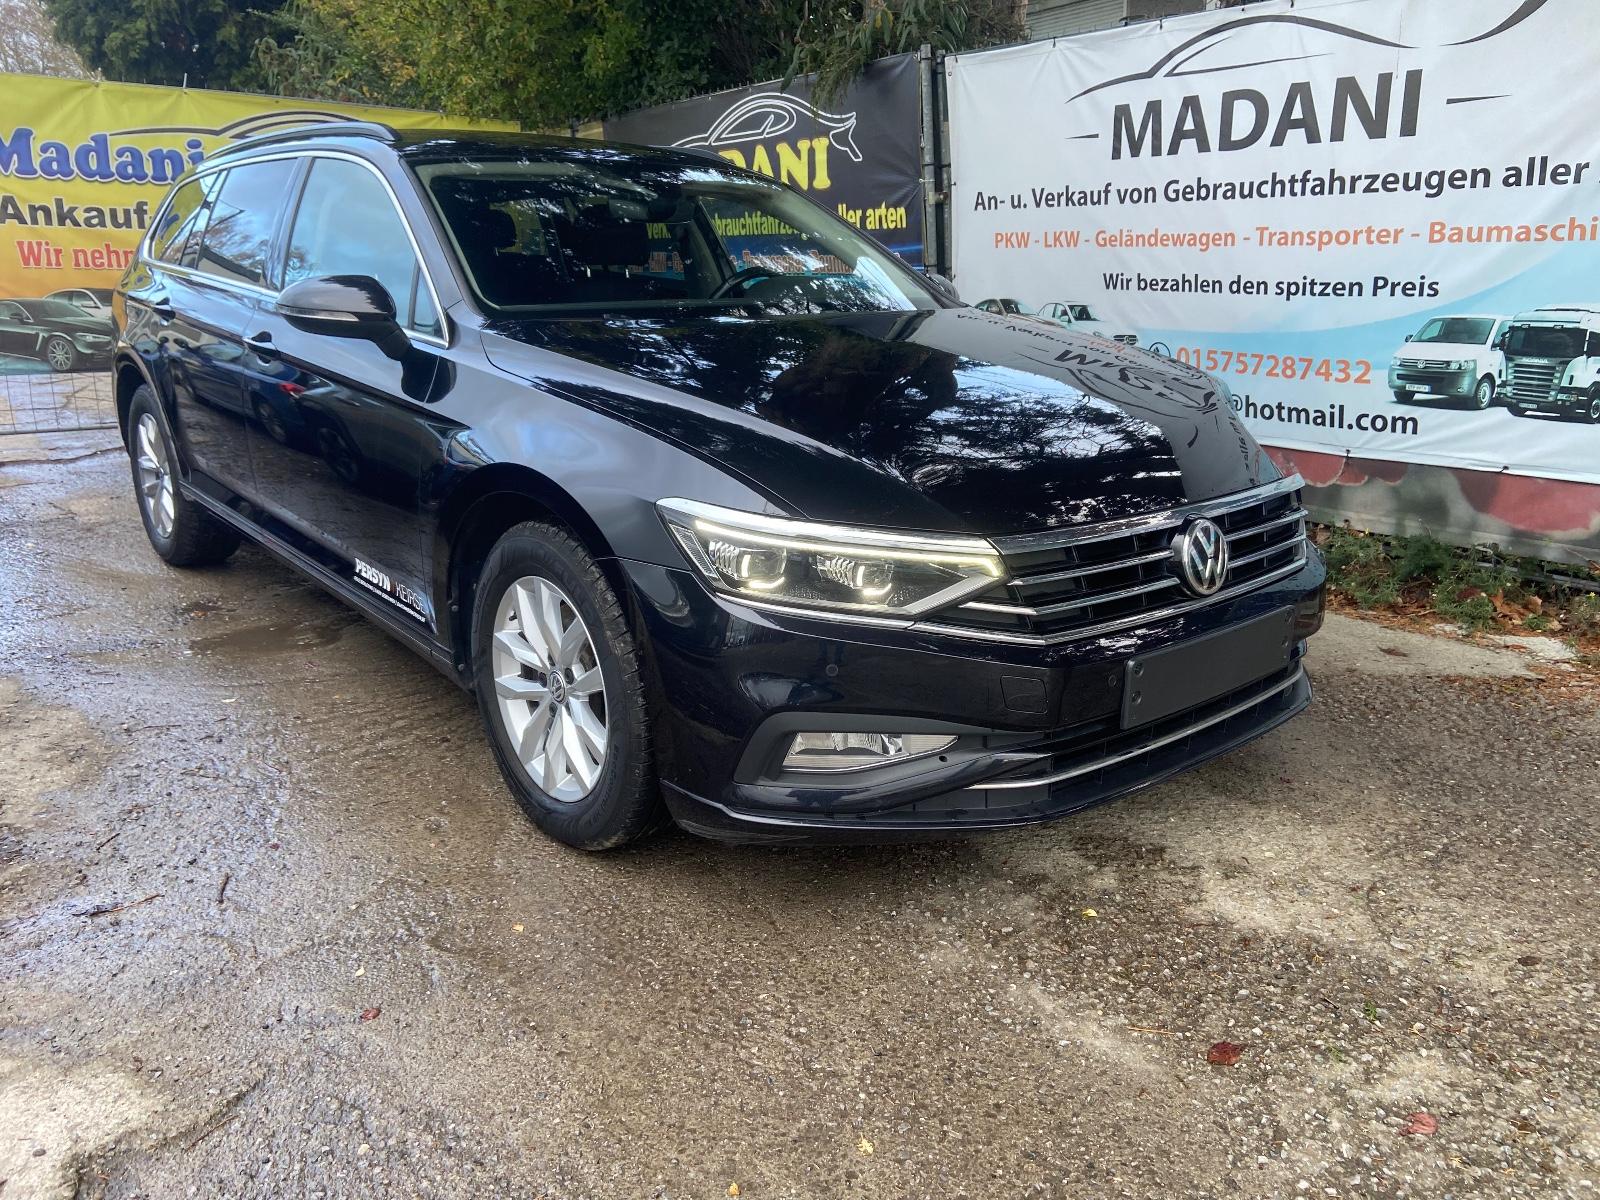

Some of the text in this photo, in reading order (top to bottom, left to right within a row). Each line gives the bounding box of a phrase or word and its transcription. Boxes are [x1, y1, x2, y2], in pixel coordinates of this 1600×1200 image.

[1111, 68, 1423, 161] MADANI
[974, 155, 1590, 212] An- u. Verkauf von Gebrauchtfahrzeugen aller
[866, 200, 906, 230] arten
[995, 231, 1031, 248] PKW
[1044, 230, 1081, 248] LKW
[1095, 229, 1236, 252] Geländewagen
[1255, 224, 1404, 252] Transporter
[1428, 216, 1599, 244] Baumaschi
[16, 240, 62, 269] Wir
[1103, 273, 1440, 301] Wir bezahlen den spitzen Preis
[1176, 347, 1371, 385] 015757287432
[355, 558, 391, 592] PERSYN
